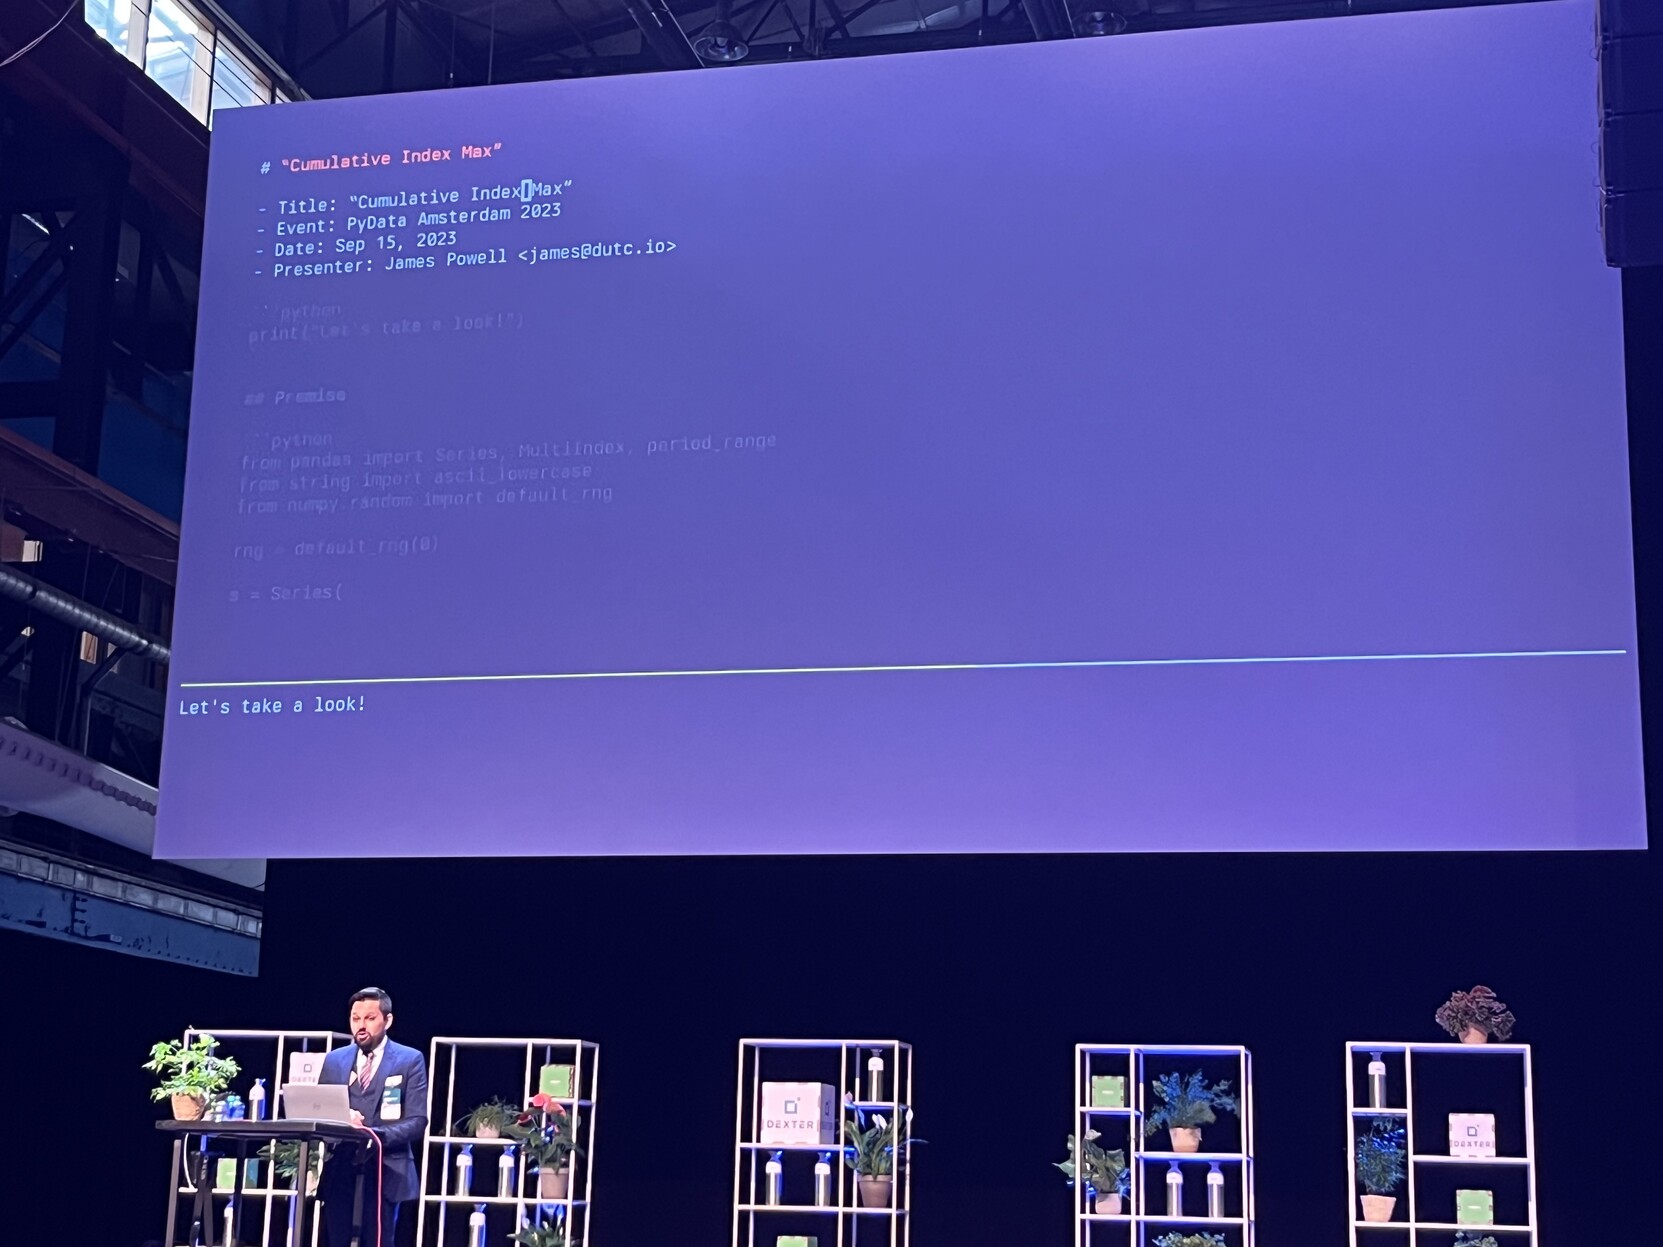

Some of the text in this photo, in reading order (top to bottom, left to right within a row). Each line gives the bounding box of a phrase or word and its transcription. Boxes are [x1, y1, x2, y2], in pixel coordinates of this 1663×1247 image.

[402, 148, 452, 164] Index
[278, 198, 336, 215] Title:
[471, 185, 521, 202] Index
[277, 219, 335, 236] Event:
[347, 214, 406, 234] PyData
[417, 206, 511, 226] Amsterdam
[520, 202, 561, 219] 2023
[274, 241, 323, 257] Date:
[335, 238, 366, 255] Sep
[376, 234, 403, 251] 15,
[416, 230, 457, 247] 2023
[274, 258, 373, 278] Presenter:
[384, 255, 436, 271] James
[446, 248, 507, 266] Powell
[518, 238, 678, 265] <james@dutc.io>
[382, 318, 422, 335] take
[432, 317, 442, 331] a
[275, 387, 346, 405] Premise
[241, 455, 281, 470] from
[290, 453, 352, 472] pandas
[362, 448, 424, 468] import
[435, 445, 505, 464] Series,
[646, 433, 777, 456] period_range
[239, 463, 592, 493] from string import ascii_lowercase
[237, 486, 613, 515] from numpy.random import default_rng
[233, 545, 264, 561] rng
[294, 534, 439, 558] default_rng(0)
[270, 582, 343, 602] Series(
[179, 695, 365, 715] Let's take a look!
[767, 1119, 814, 1129] DEXTER
